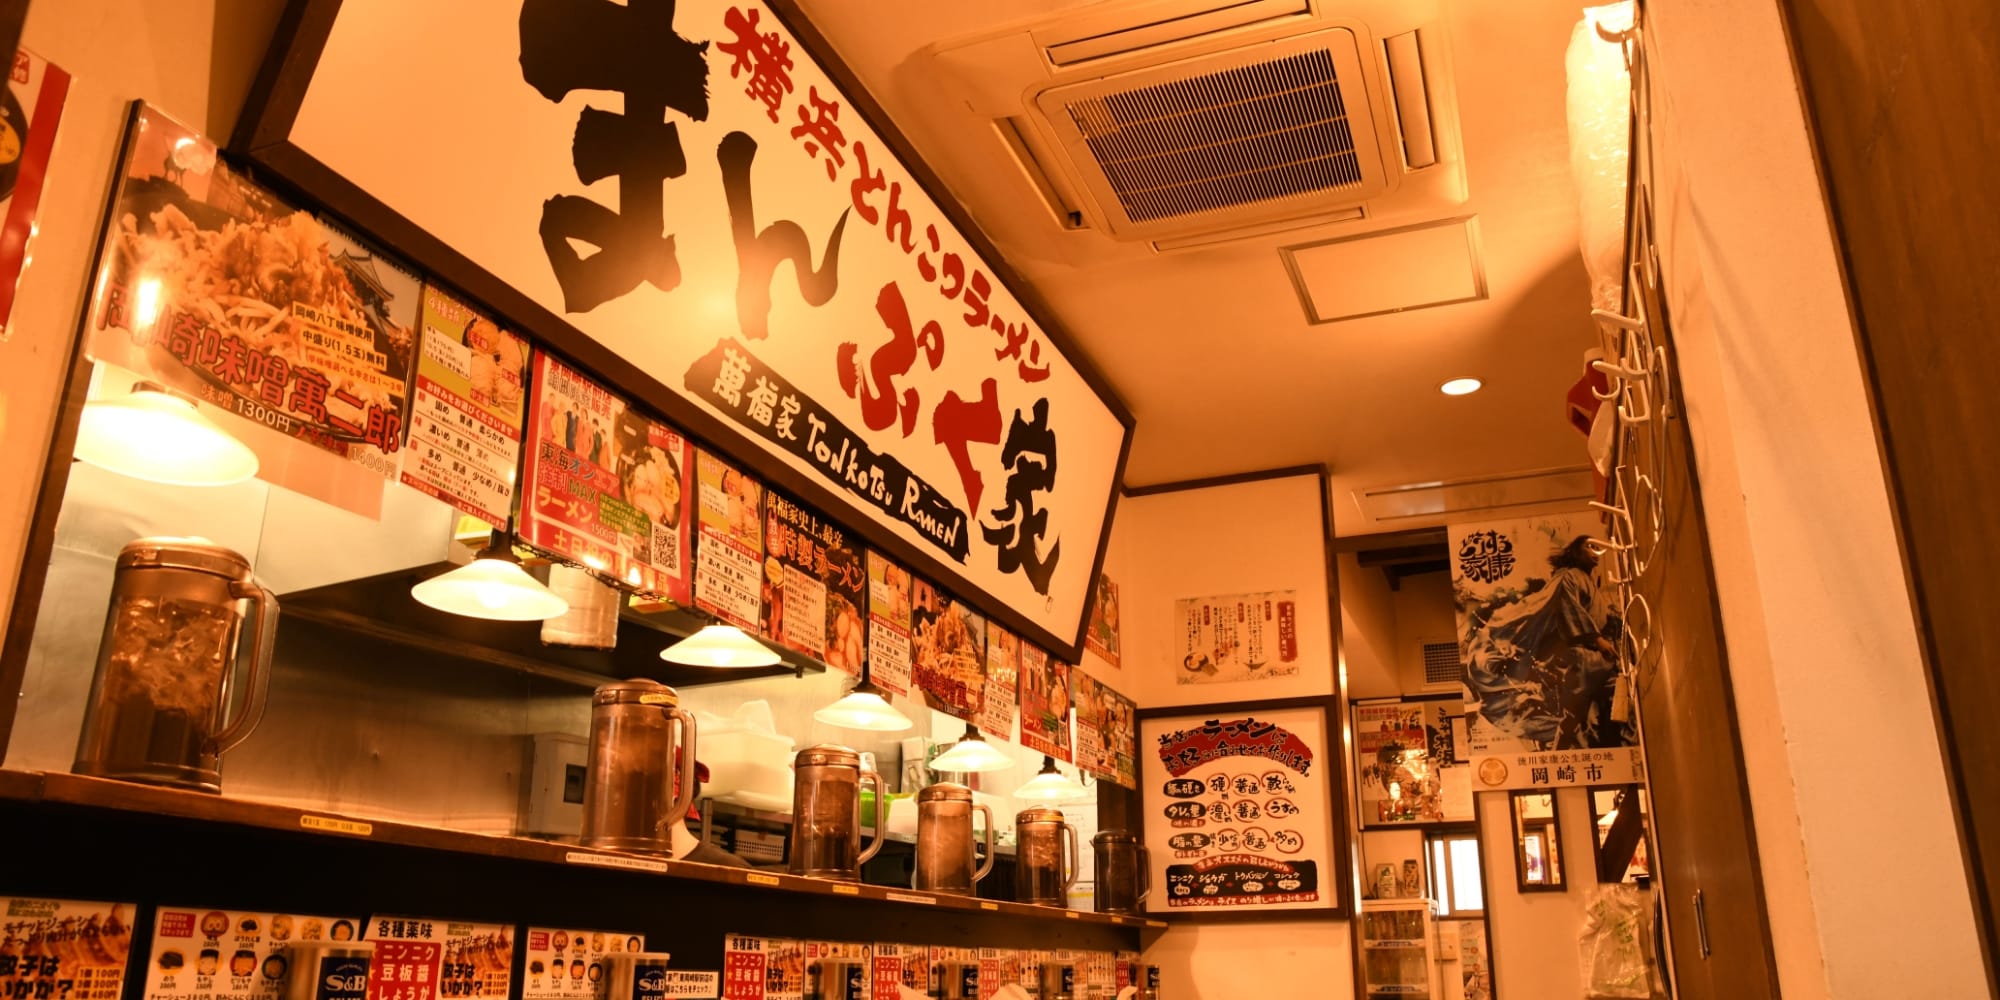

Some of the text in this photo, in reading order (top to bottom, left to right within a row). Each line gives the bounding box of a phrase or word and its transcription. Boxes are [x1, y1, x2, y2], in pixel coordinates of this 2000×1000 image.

[716, 6, 1050, 383] 横浜とんこつラーメン
[519, 0, 1061, 596] まんぷく家
[712, 348, 801, 441] 萬福家
[236, 398, 290, 432] 1300円
[542, 442, 620, 492] 東海オンエア
[537, 485, 593, 523] ラーメン
[779, 523, 865, 593] 特製ラーメン
[1158, 717, 1288, 748] 当店のラーメンは
[1518, 751, 1615, 766] 徳川家康公生誕の地
[1532, 763, 1603, 785] 岡崎市
[1170, 873, 1195, 884] ニンニク
[378, 920, 433, 939] 各種薬味
[383, 944, 434, 960] ニンニク
[735, 955, 763, 967] ニンニク
[96, 969, 120, 977] 100円
[325, 974, 367, 991] S&B
[380, 963, 429, 982] 豆板醤
[94, 980, 118, 989] 300円
